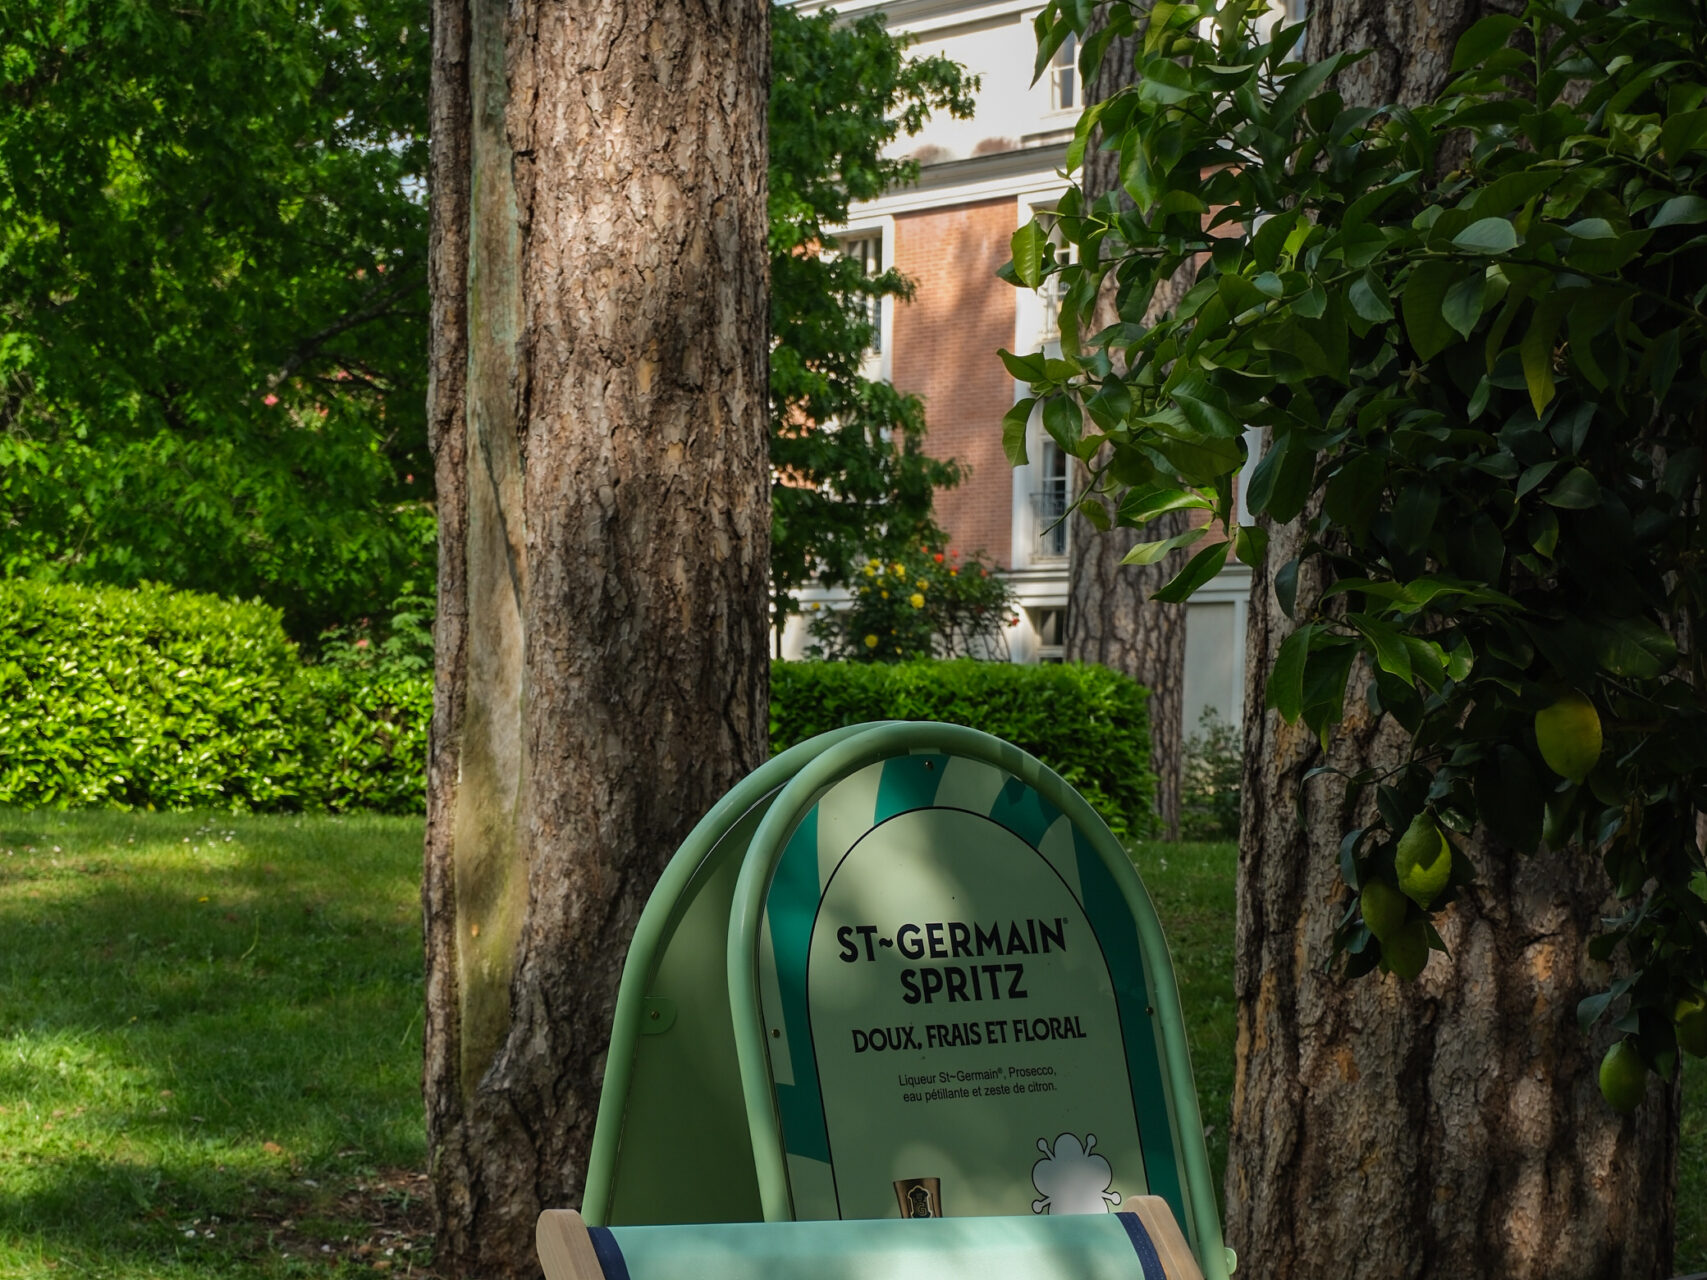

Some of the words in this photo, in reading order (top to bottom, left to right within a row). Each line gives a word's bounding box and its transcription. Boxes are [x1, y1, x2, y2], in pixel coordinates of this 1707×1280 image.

[900, 963, 1028, 1005] SPRITZ
[852, 1025, 923, 1053] DOUX,
[925, 1022, 982, 1048] FRAIS
[985, 1020, 1008, 1044] ET
[1012, 1016, 1087, 1042] FLORAL
[898, 1074, 936, 1087] Liqueur
[1008, 1066, 1057, 1078] Prosecco,
[903, 1092, 923, 1102] eau
[925, 1087, 969, 1103] pétillante
[972, 1086, 983, 1097] et
[984, 1085, 1010, 1096] zeste
[1013, 1082, 1026, 1094] de
[1028, 1081, 1057, 1093] citron.
